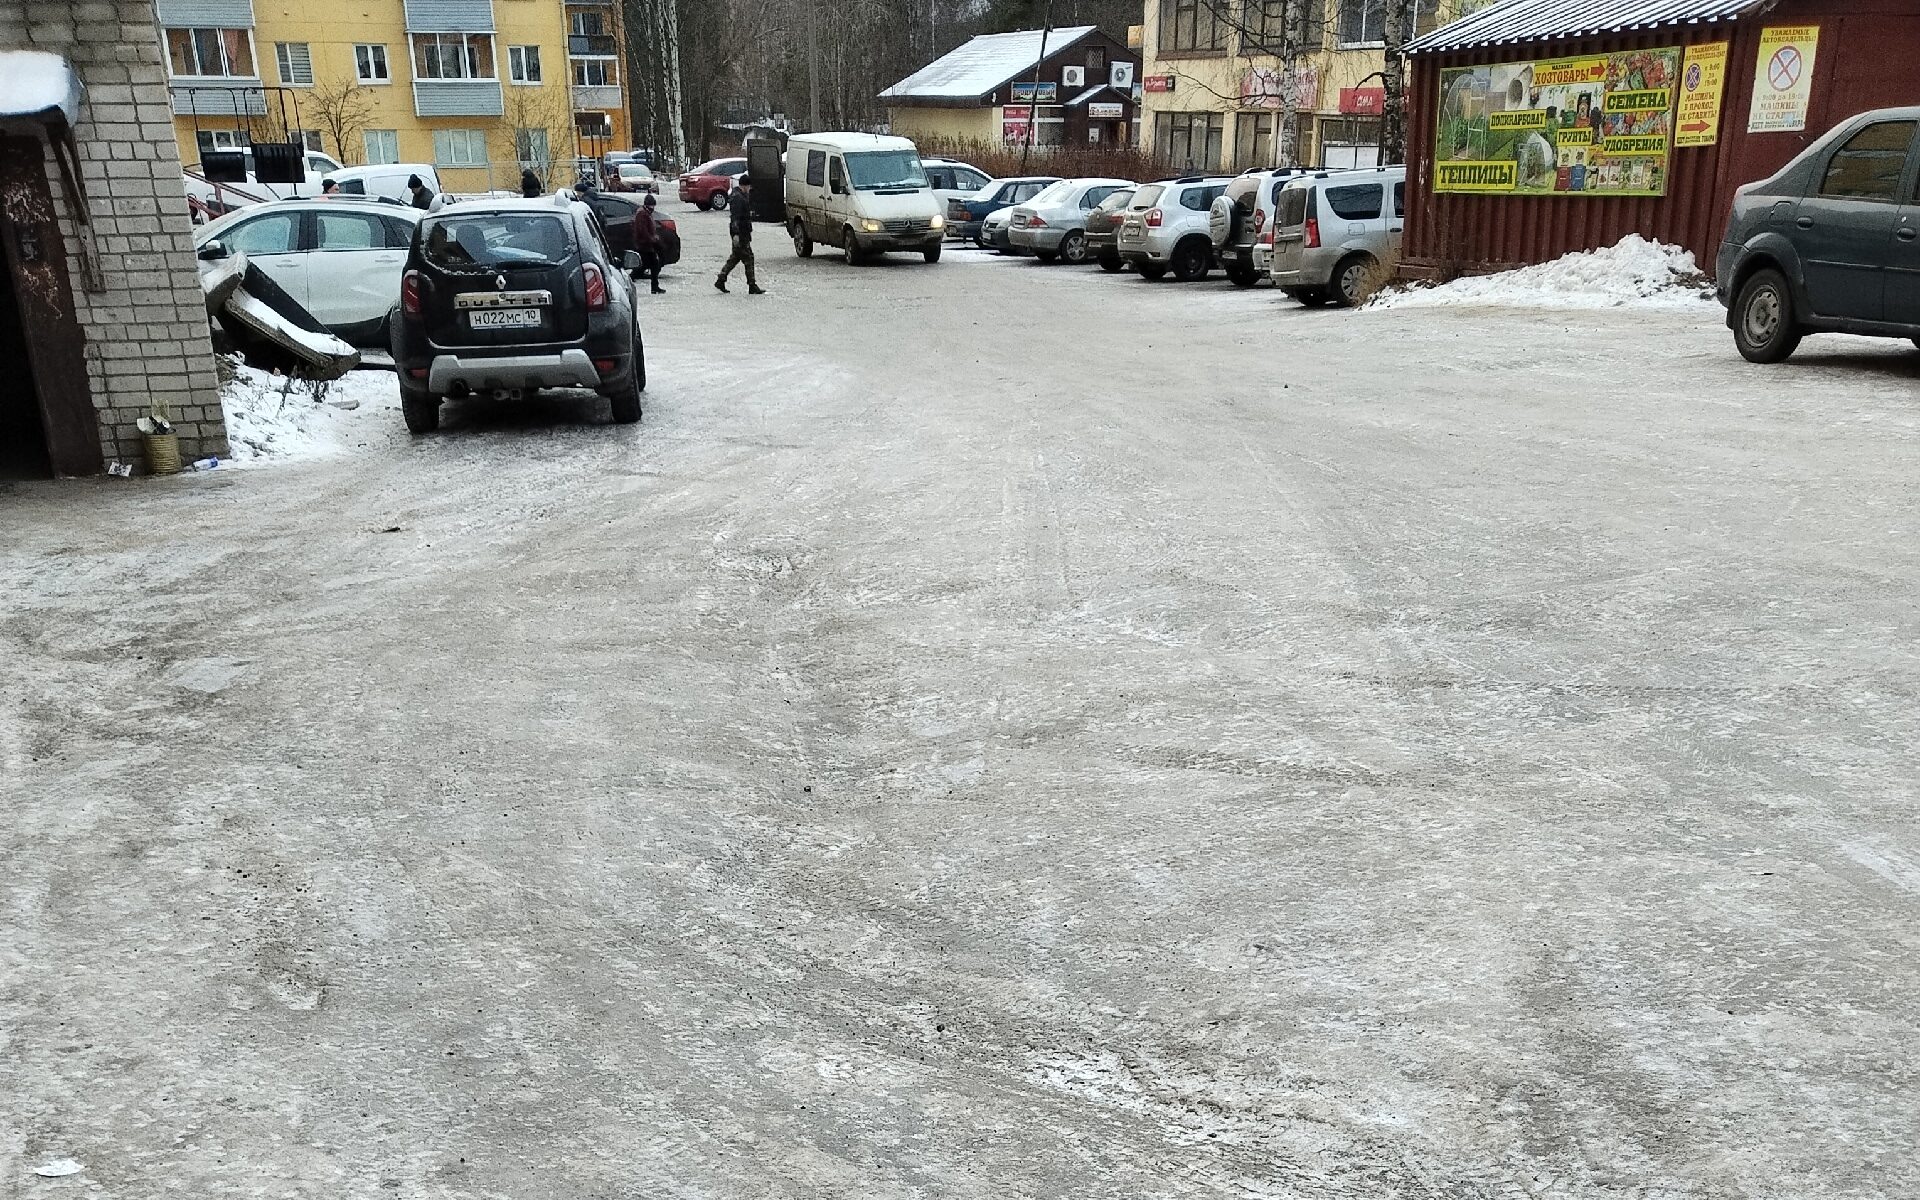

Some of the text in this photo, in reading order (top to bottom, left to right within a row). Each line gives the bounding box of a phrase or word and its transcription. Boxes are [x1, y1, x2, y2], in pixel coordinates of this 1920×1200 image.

[1535, 68, 1590, 85] ХОЗТОВАРЫ
[1607, 92, 1667, 110] СЕМЕНА
[1685, 92, 1715, 102] МАШИНЫ
[1491, 113, 1545, 126] ПОЛИКАРБОНАТ
[1558, 131, 1592, 143] ГРУНТЫ
[1604, 138, 1664, 152] УДОБРЕНИЯ
[1439, 165, 1515, 186] ТЕПЛИЦЫ
